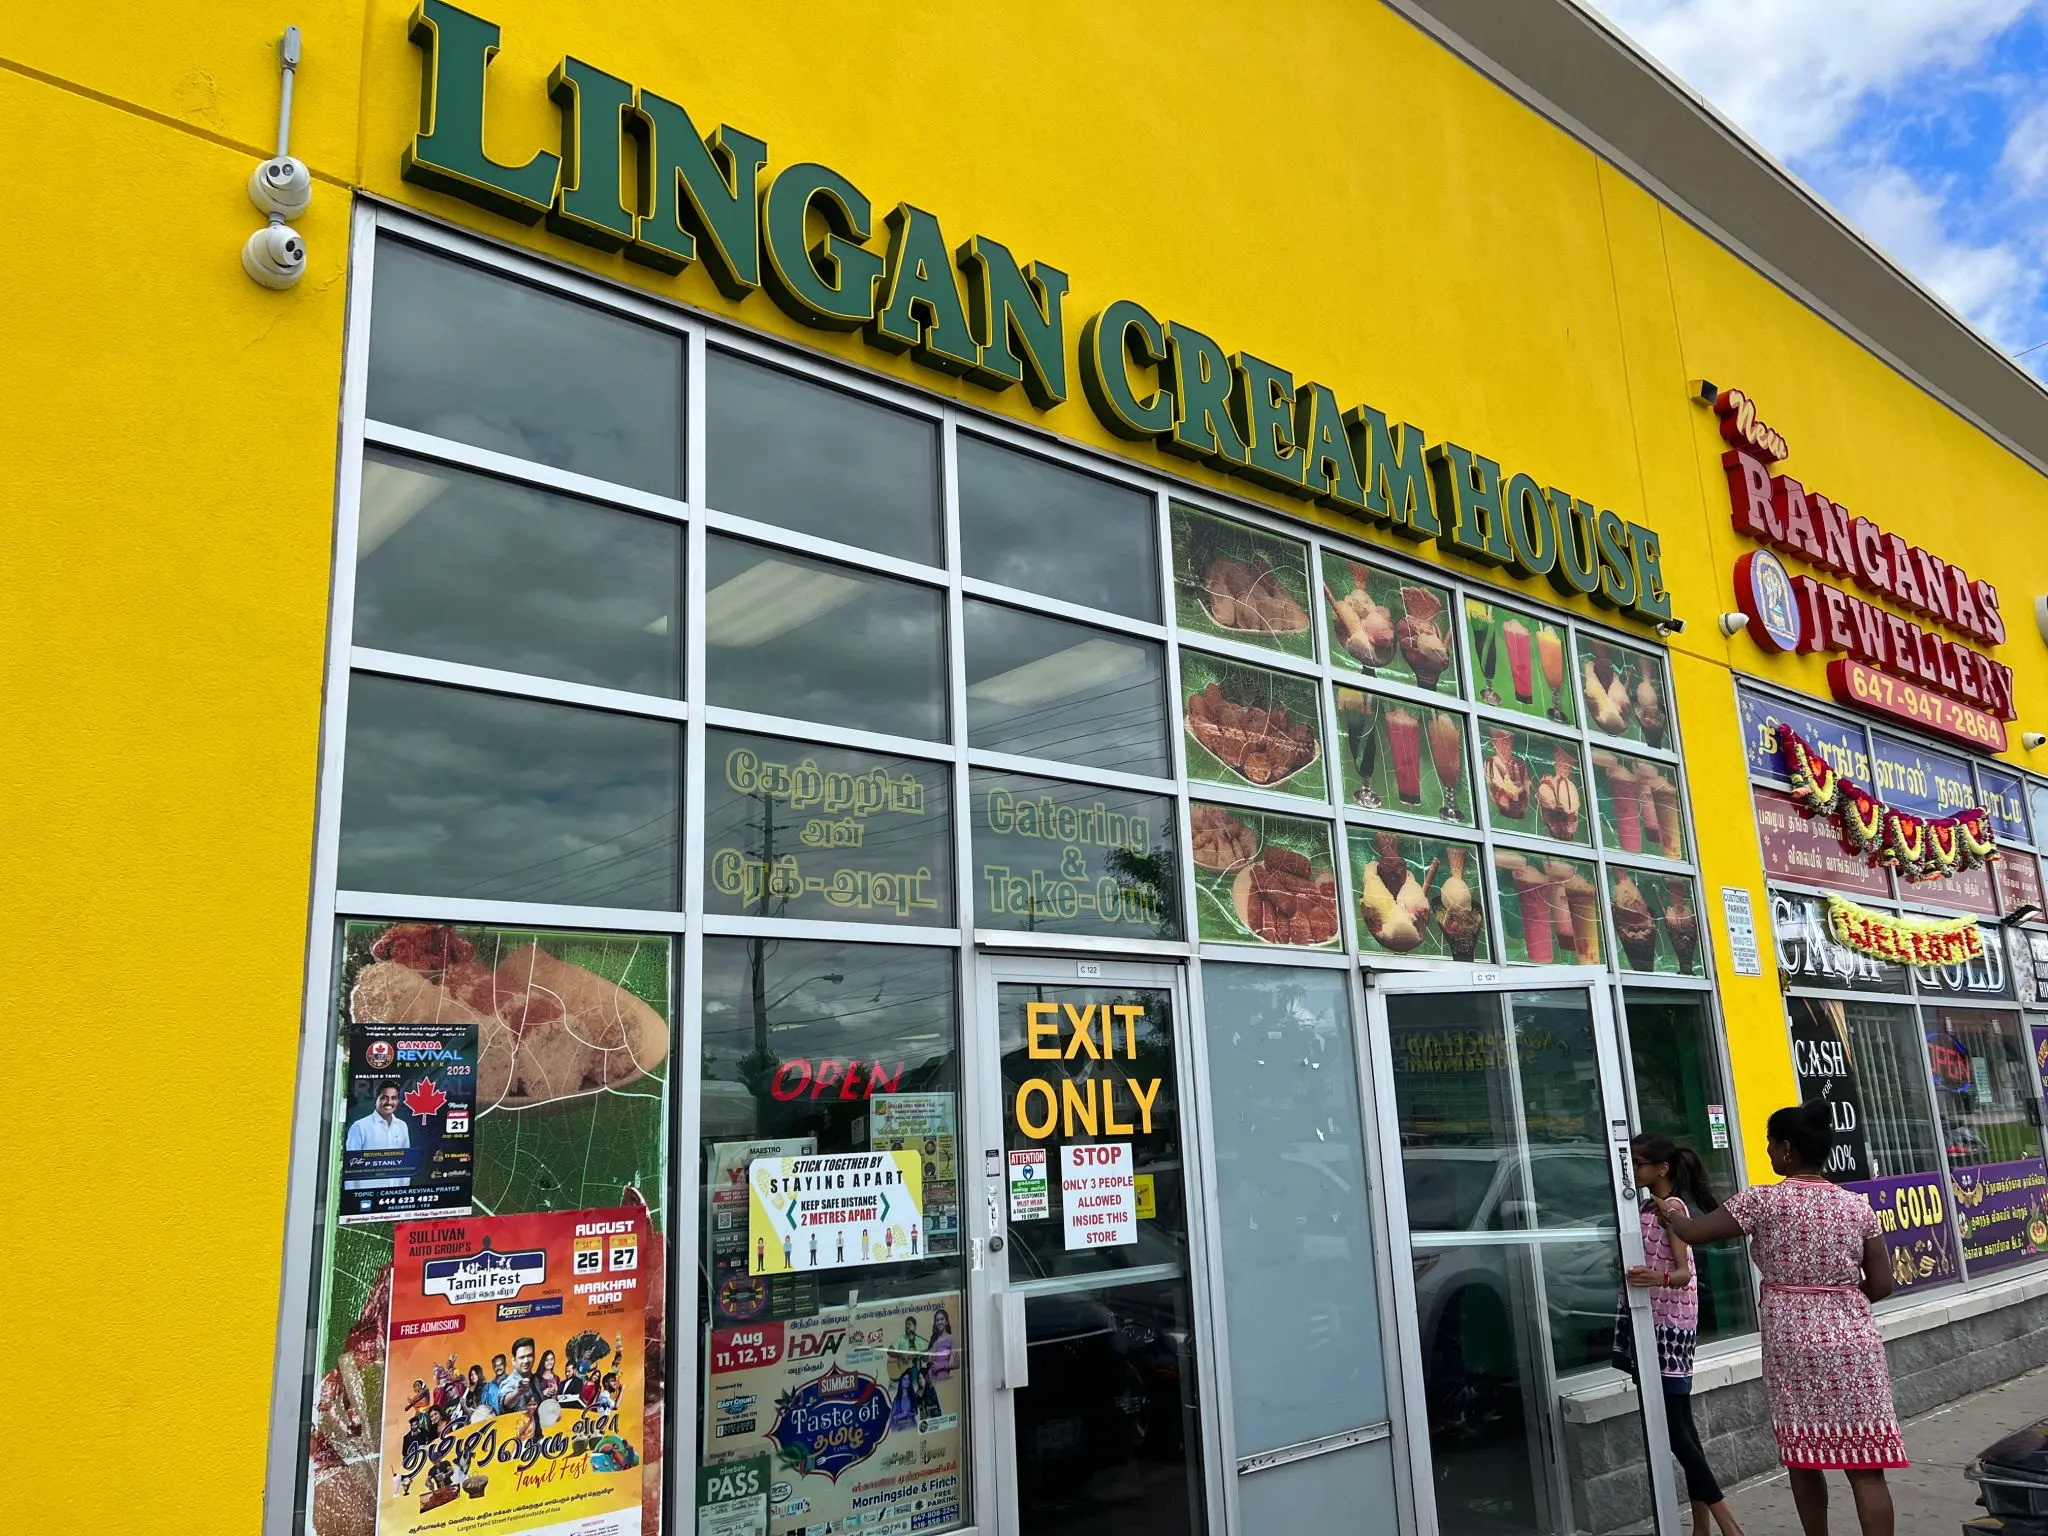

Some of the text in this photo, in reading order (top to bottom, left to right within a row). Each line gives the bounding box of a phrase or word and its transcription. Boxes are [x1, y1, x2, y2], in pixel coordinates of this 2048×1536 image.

[402, 0, 1672, 626] LINGAN CREAM HOUSE
[1714, 388, 1789, 464] New
[1722, 449, 2006, 646] RANGANAS
[1790, 575, 2017, 721] JEWELLERY
[1852, 665, 2001, 746] 647-947-2864
[800, 817, 864, 848] அன்
[987, 786, 1151, 860] Catering
[1061, 846, 1090, 882] &
[984, 864, 1161, 925] Take-Out
[1727, 904, 1748, 914] PARKING
[1841, 911, 1982, 963] WELCOME
[1087, 966, 1098, 974] 122
[1026, 1002, 1145, 1060] EXIT
[397, 1041, 442, 1050] CANADA
[397, 1050, 463, 1060] REVIVAL
[1795, 1039, 1847, 1077] CASH
[447, 1066, 471, 1076] 2023
[771, 1058, 904, 1102] OPEN
[1821, 1079, 1833, 1099] FOR
[1015, 1078, 1162, 1139] ONLY
[1833, 1101, 1856, 1132] LD
[452, 1121, 464, 1130] 21
[750, 1146, 780, 1154] MAESTRO
[1011, 1152, 1044, 1165] ATTENTION
[1072, 1146, 1122, 1167] STOP
[1826, 1145, 1856, 1173] 00%
[792, 1155, 884, 1174] STICK TOGETHER BY
[770, 1174, 844, 1193] STAYING
[853, 1170, 903, 1188] APART
[1063, 1175, 1133, 1191] ONLY 3 PEOPLE
[379, 1197, 396, 1205] 644
[398, 1196, 415, 1204] 623
[801, 1195, 877, 1211] KEEP SAFE DISTANCE
[1078, 1194, 1122, 1208] ALLOWED
[1876, 1184, 1943, 1233] FOR GOLD
[801, 1207, 877, 1226] 2 METRES APART
[1073, 1212, 1128, 1227] INSIDE THIS
[409, 1227, 465, 1245] SULLIVAN
[575, 1220, 634, 1236] AUGUST
[1086, 1230, 1117, 1244] STORE
[409, 1241, 471, 1257] AUTO GROUP'S
[583, 1241, 593, 1249] SAT
[577, 1249, 635, 1268] 26 27
[447, 1272, 520, 1291] Tamil Fest
[574, 1278, 637, 1295] MARKHAM
[588, 1291, 622, 1305] ROAD
[401, 1319, 460, 1336] FREE ADMISSION
[731, 1330, 763, 1347] Aug
[717, 1345, 776, 1367] 11, 12, 13
[821, 1375, 855, 1393] SUMMER
[717, 1396, 757, 1409] EAST COURT
[791, 1397, 880, 1435] Taste of
[813, 1422, 865, 1451] தமிழ்
[514, 1453, 590, 1492] Tamil Fest
[707, 1469, 760, 1502] PASS
[852, 1485, 918, 1510] Morningside
[920, 1482, 928, 1493] &
[930, 1475, 957, 1491] Finch
[934, 1489, 952, 1498] FREE
[927, 1495, 958, 1508] PARKING
[507, 1513, 526, 1521] Festival
